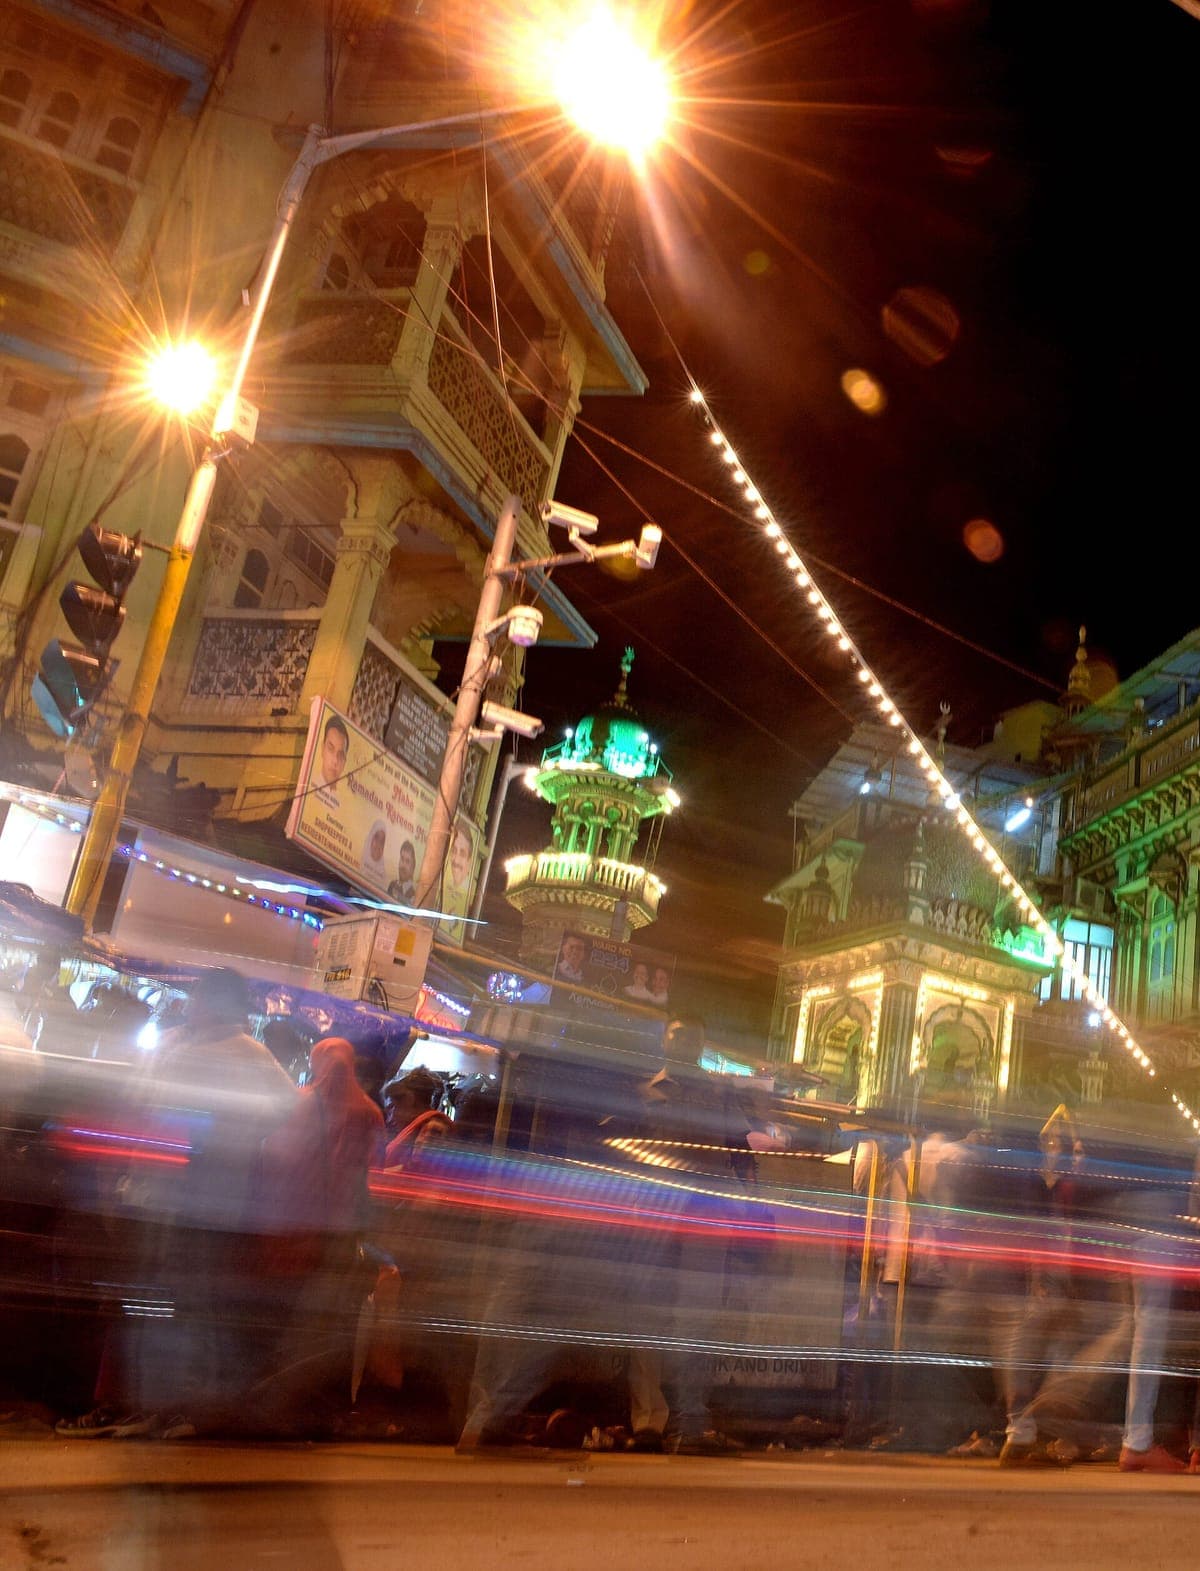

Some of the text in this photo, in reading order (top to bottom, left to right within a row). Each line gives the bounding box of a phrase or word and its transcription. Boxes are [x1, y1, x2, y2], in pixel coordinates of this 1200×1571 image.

[347, 771, 384, 812] Ramadan
[592, 938, 617, 954] WARD
[733, 1358, 768, 1374] AND
